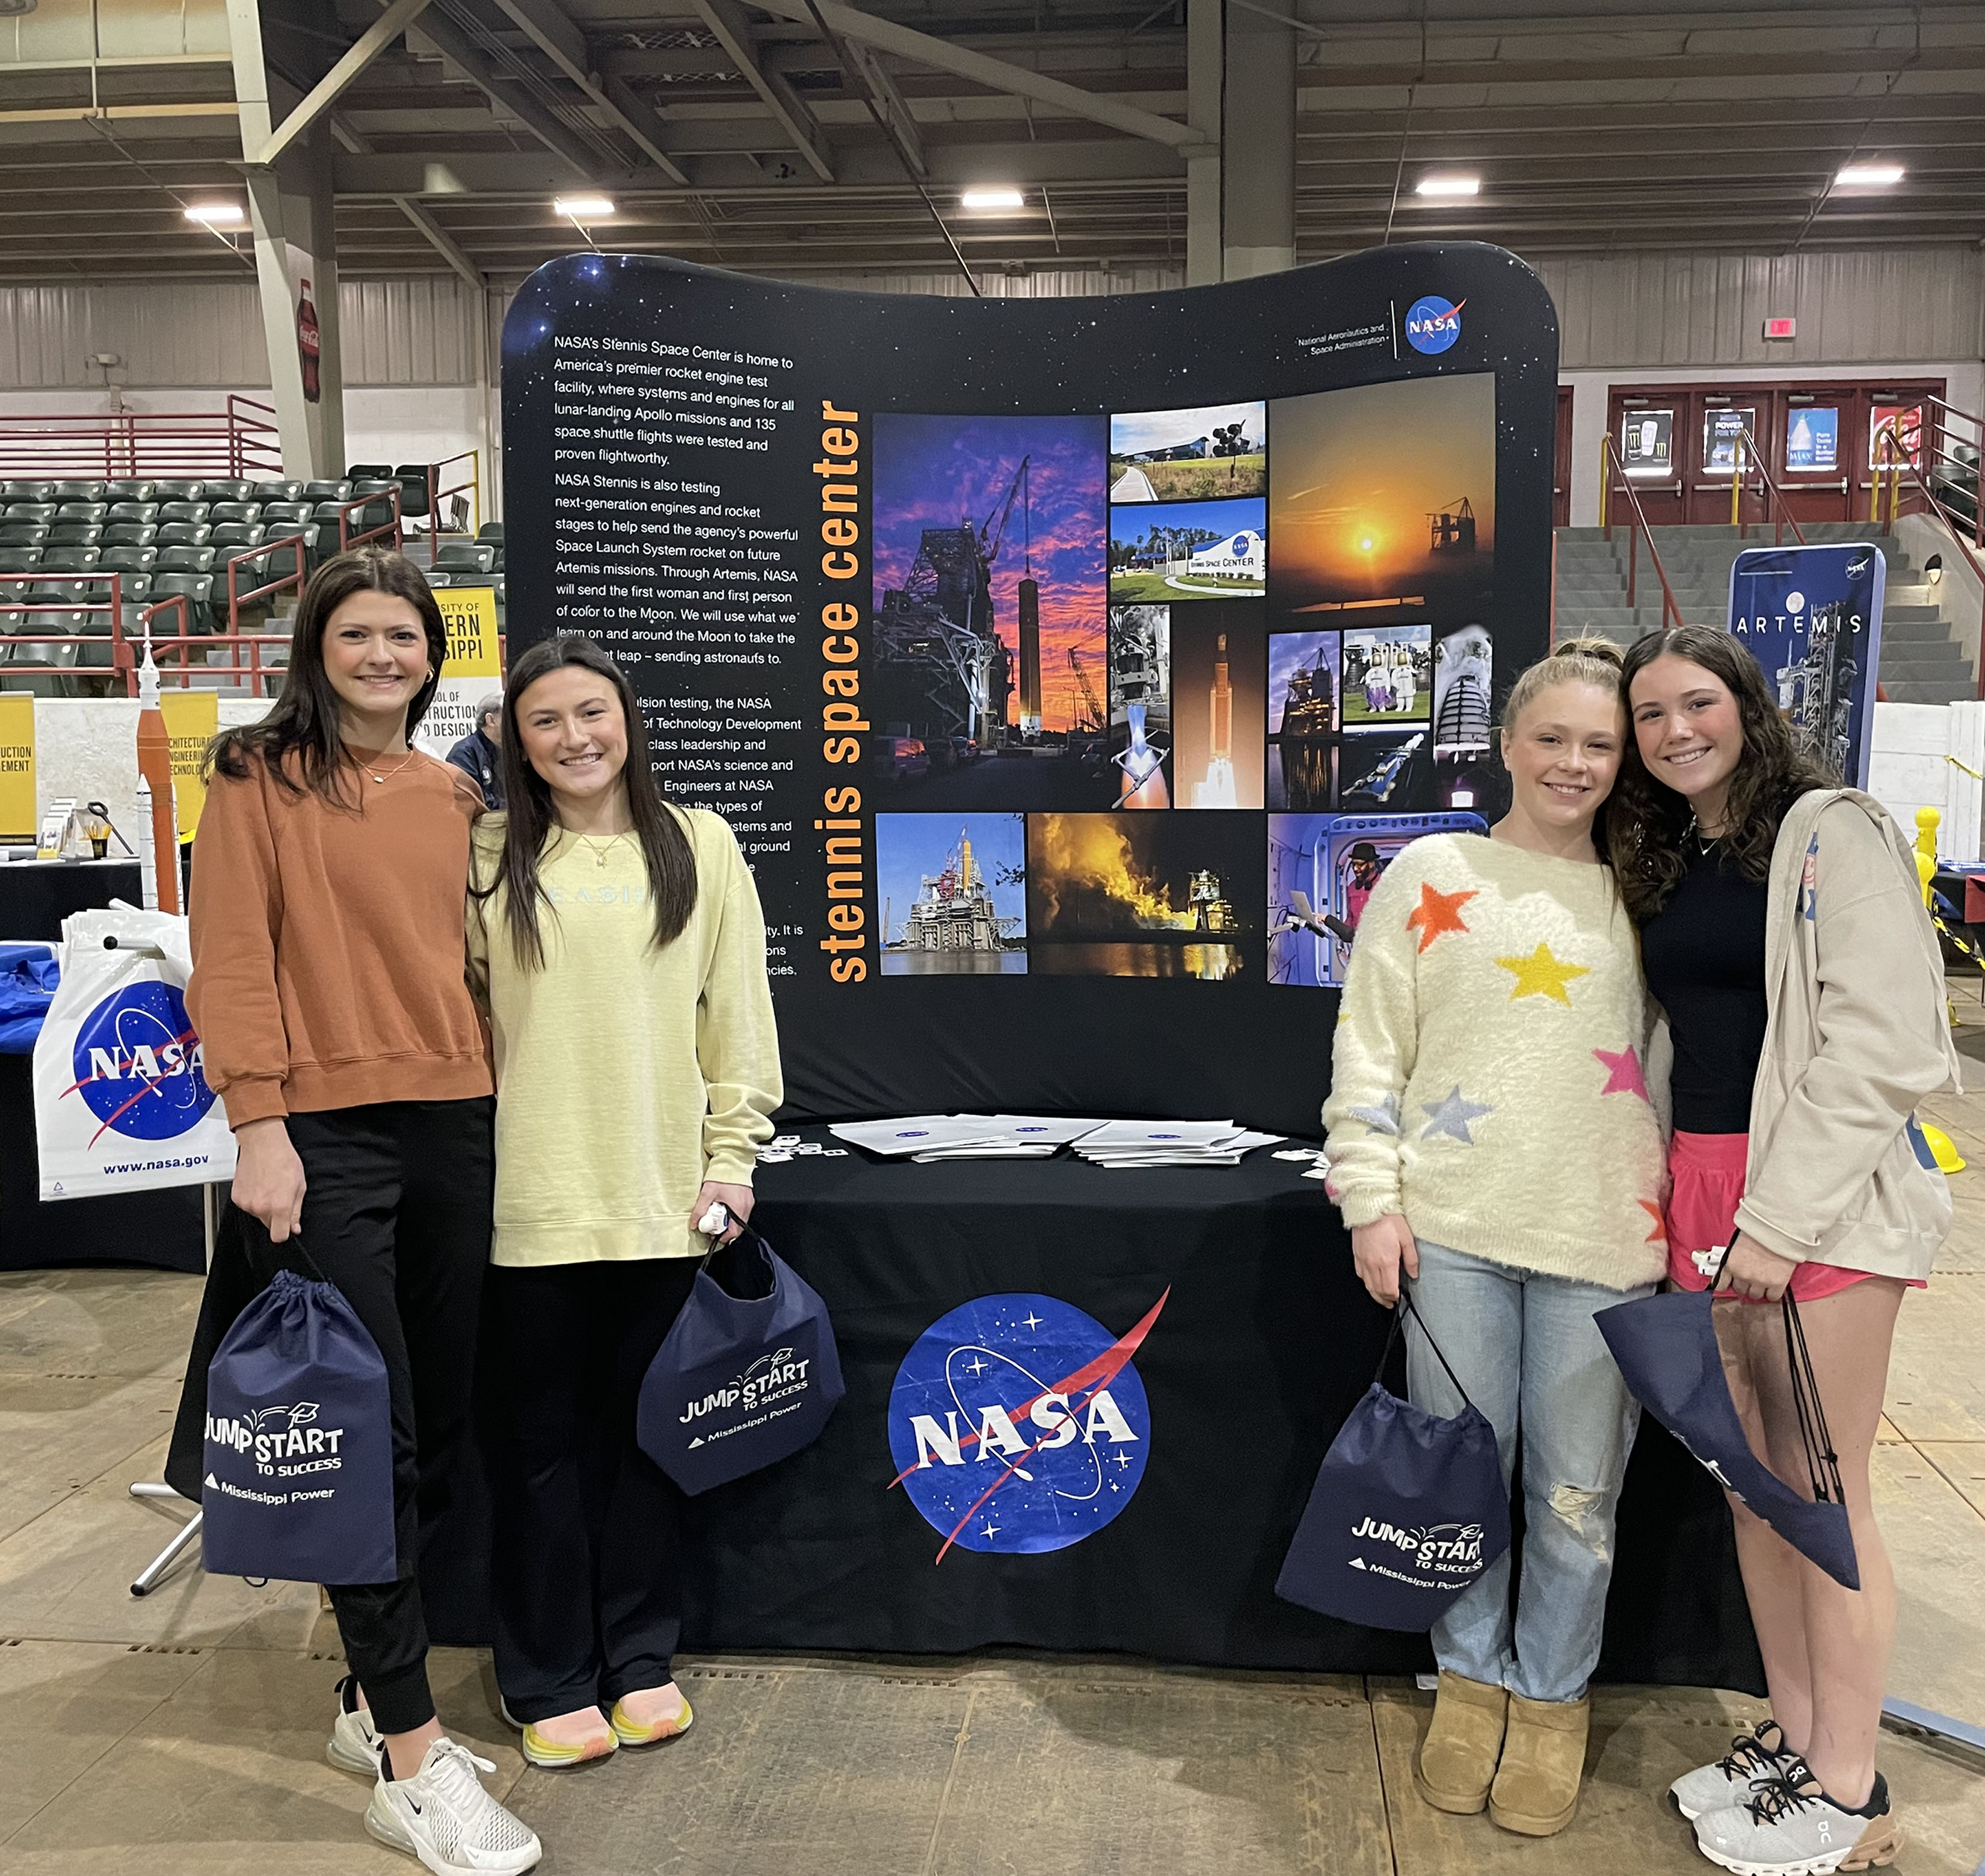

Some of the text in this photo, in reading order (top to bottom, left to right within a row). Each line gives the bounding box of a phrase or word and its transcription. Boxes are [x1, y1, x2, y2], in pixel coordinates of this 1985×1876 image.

[1299, 324, 1384, 346] National Aeronautics and
[1409, 318, 1458, 334] NASA
[555, 337, 793, 368] NASA's Stennis Space Center is home to
[1311, 336, 1385, 355] Space Administration
[554, 358, 768, 387] America's premier rocket engine test
[555, 381, 793, 410] facility, where systems and engines for all
[555, 403, 775, 430] lunar-landing Apollo missions and 135
[555, 427, 768, 451] space shuttle flights were tested and
[555, 449, 669, 467] proven flightworthy.
[556, 474, 719, 496] NASA Stennis is also testing
[556, 497, 760, 518] next-generation engines and rocket
[556, 519, 798, 540] stages to help send the agency's powerful
[556, 540, 592, 553] Space
[597, 541, 639, 553] Launch
[643, 543, 686, 557] System
[691, 547, 725, 558] rocket
[748, 549, 780, 561] future
[555, 562, 798, 582] Artemis missions. Through Artemis, NASA
[1223, 558, 1254, 567] CENTER
[556, 584, 792, 603] will send the first woman and first person
[466, 603, 479, 611] OF
[556, 605, 568, 616] of
[571, 605, 600, 617] color
[603, 607, 615, 617] to
[619, 607, 636, 618] the
[640, 606, 676, 620] Moon.
[681, 609, 699, 620] We
[703, 610, 721, 620] will
[748, 612, 775, 623] what
[780, 615, 796, 623] we
[446, 614, 480, 637] ERN
[1737, 615, 1862, 634] ARTEMIS
[589, 630, 603, 638] on
[606, 629, 628, 639] and
[632, 630, 672, 640] around
[676, 630, 694, 641] the
[698, 631, 731, 642] Moon
[734, 633, 746, 642] to
[749, 633, 774, 643] take
[777, 633, 795, 644] the
[617, 650, 641, 663] leap
[655, 651, 700, 665] sending
[449, 691, 460, 702] OF
[814, 399, 870, 983] stennis space center
[669, 698, 772, 711] testing, the NASA
[434, 722, 472, 736] DESIGN
[656, 718, 801, 731] Technology Development
[1, 746, 31, 758] UCTION
[682, 739, 765, 752] leadership and
[679, 760, 793, 770] NASA's science and
[665, 780, 774, 794] Engineers at NASA
[716, 801, 762, 814] types of
[771, 821, 791, 831] and
[750, 841, 790, 854] ground
[103, 1154, 209, 1175] www.nasa.gov
[743, 1380, 808, 1412] TO SUCCESS
[708, 1402, 802, 1442] Mississippi Power
[909, 1390, 1140, 1469] NASA
[256, 1458, 342, 1477] TO SUCCESS
[221, 1482, 335, 1505] Mississippi Power
[1415, 1559, 1432, 1569] TO
[1369, 1563, 1472, 1590] Mississippi Power
